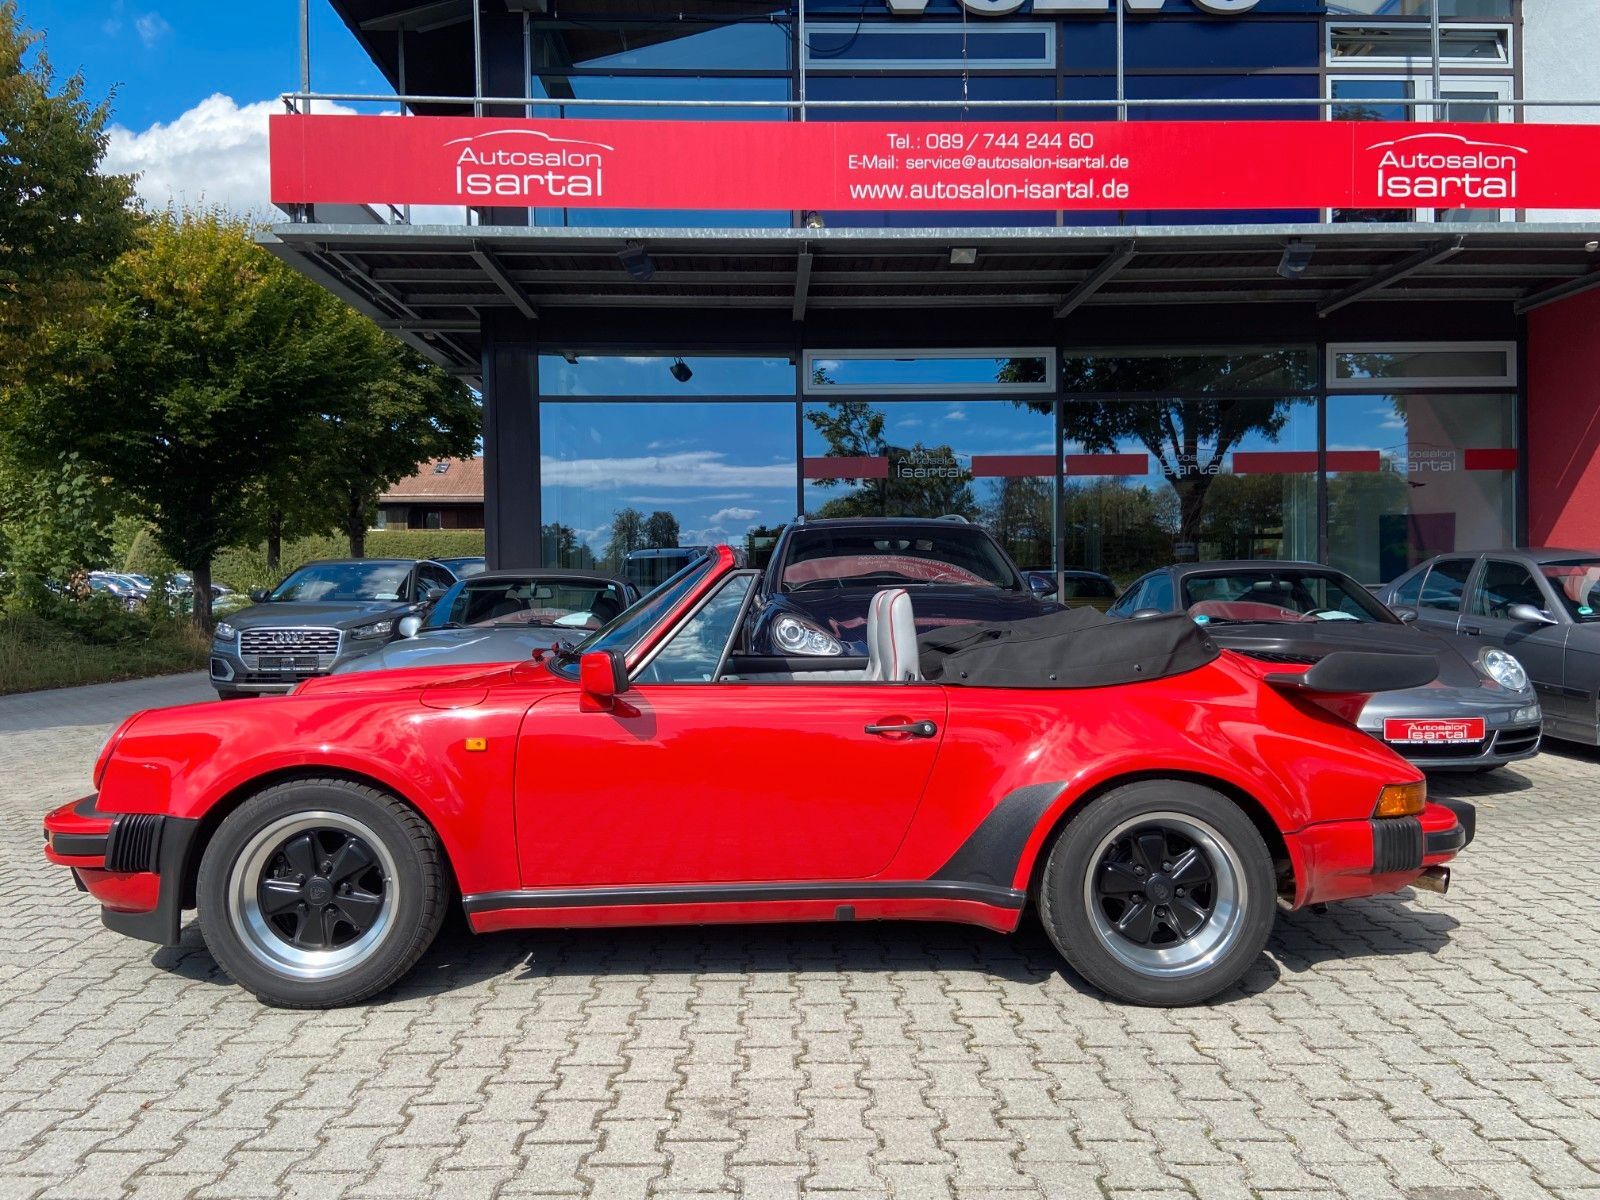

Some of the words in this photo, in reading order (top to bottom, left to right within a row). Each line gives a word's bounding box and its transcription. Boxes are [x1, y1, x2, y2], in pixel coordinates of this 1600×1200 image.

[886, 133, 920, 149] Tel.:
[1025, 133, 1062, 149] 244
[1068, 133, 1094, 149] 60
[457, 147, 602, 167] Autosalon
[848, 154, 899, 169] E-Mail:
[905, 154, 1129, 170] service@autosalon-isartal.de
[1379, 151, 1516, 169] Autosalon
[456, 166, 602, 197] Isartal
[849, 178, 1129, 199] www.autosalon-isartal.de
[1377, 168, 1516, 198] Isartal
[1159, 452, 1224, 462] Atoslon
[1159, 462, 1224, 475] sarta
[1408, 728, 1467, 739] Isartal
[1409, 723, 1467, 731] Autosalon
